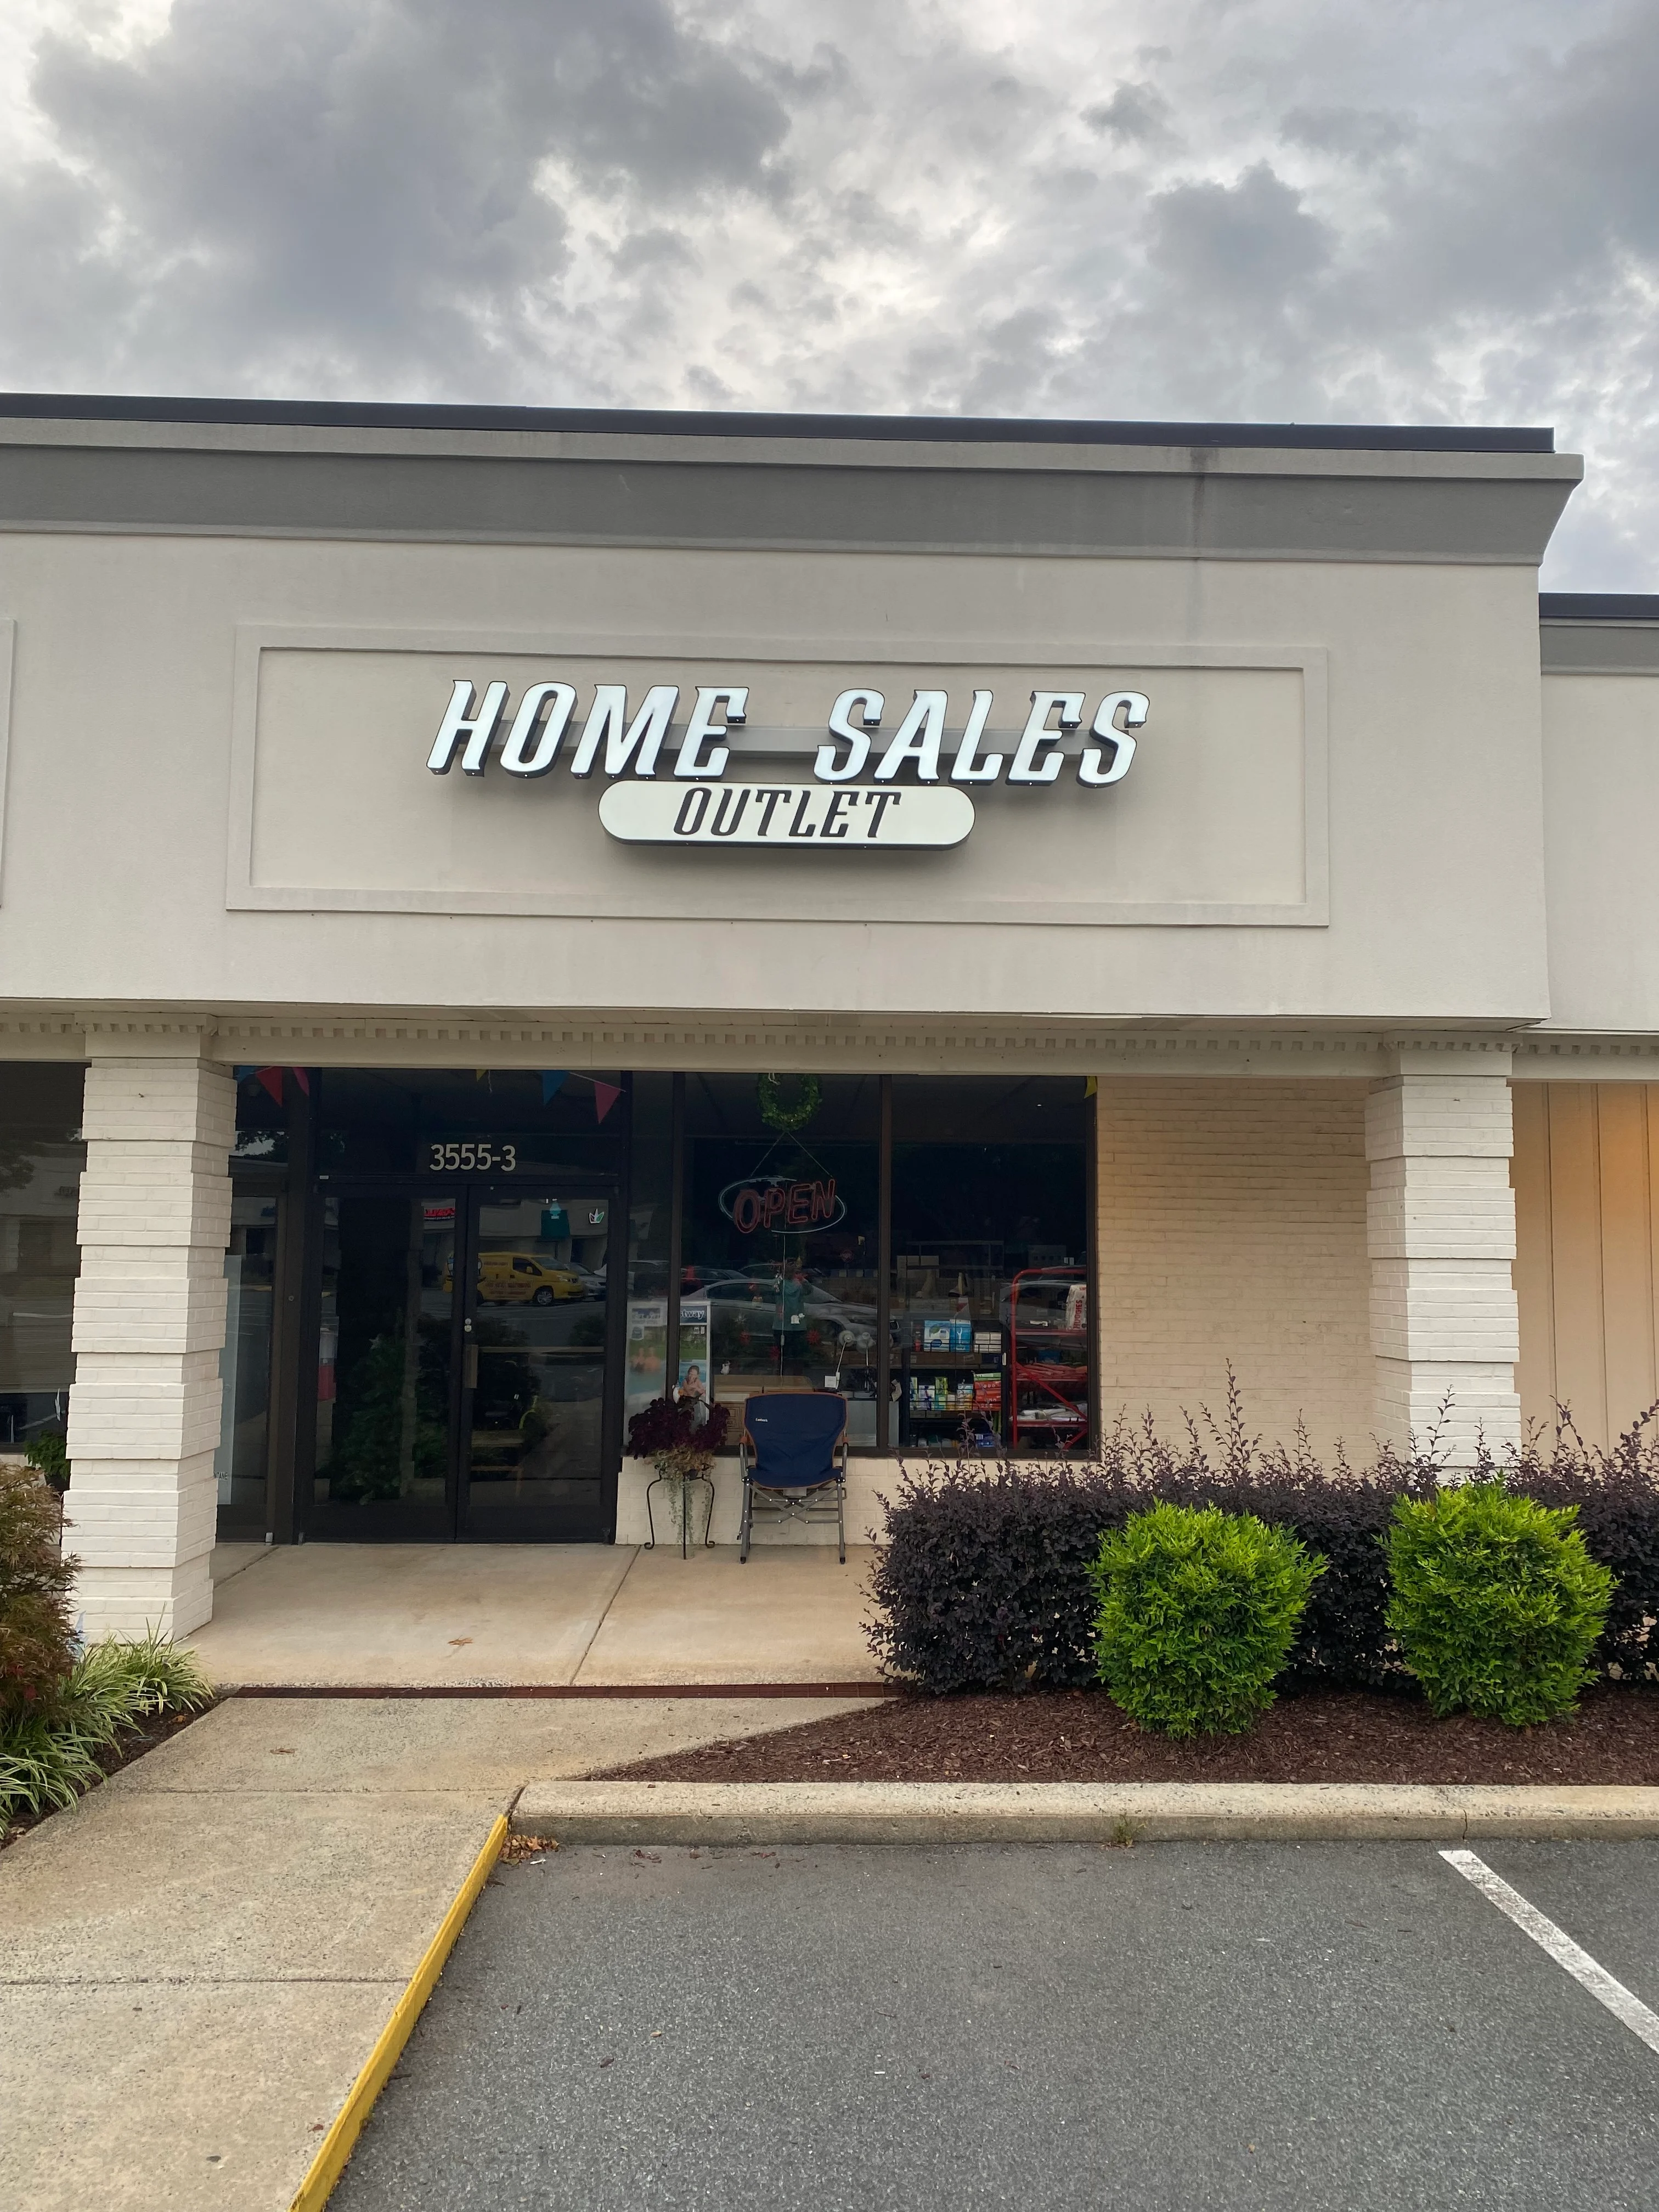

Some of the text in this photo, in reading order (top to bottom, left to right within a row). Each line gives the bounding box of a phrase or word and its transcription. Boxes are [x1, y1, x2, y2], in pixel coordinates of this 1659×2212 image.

[426, 680, 1150, 786] HOME SALES
[673, 787, 902, 838] OUTLET
[429, 1143, 516, 1171] 3555-3
[732, 1178, 836, 1234] OPEN
[1073, 1300, 1082, 1329] HUGGIES
